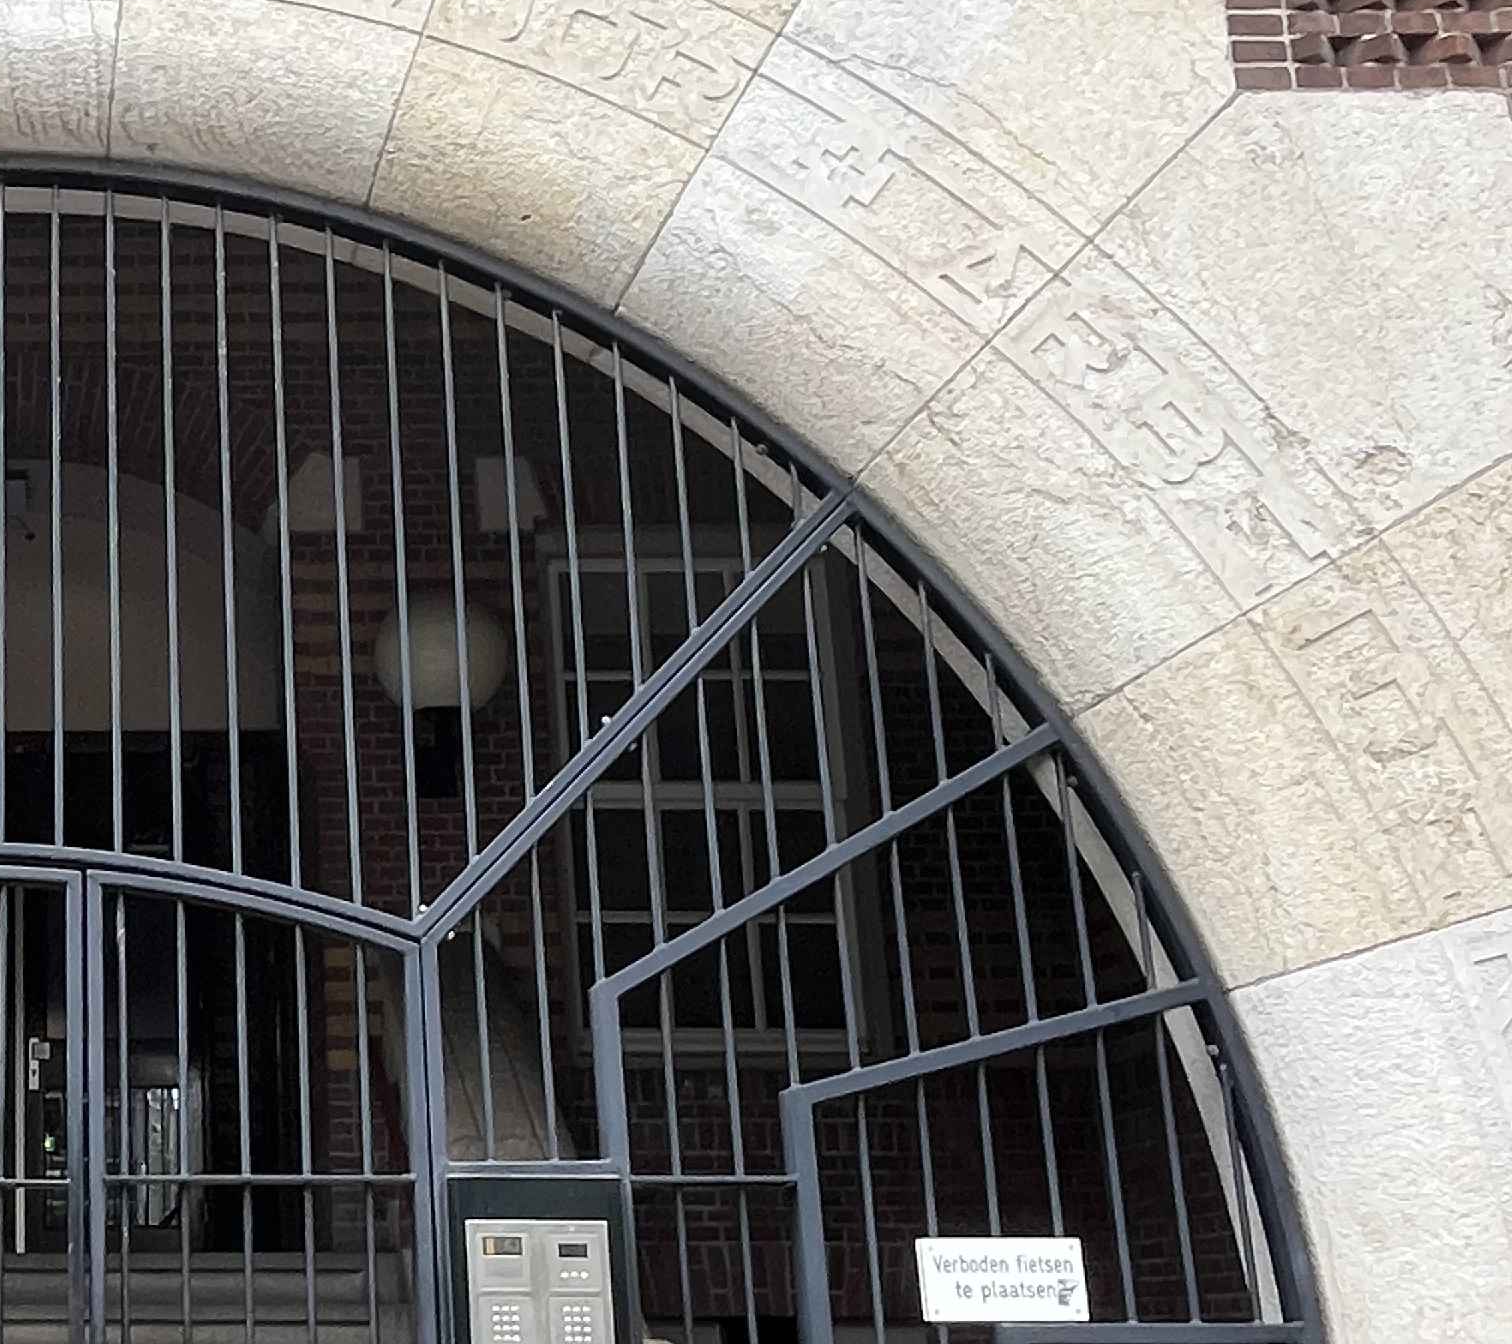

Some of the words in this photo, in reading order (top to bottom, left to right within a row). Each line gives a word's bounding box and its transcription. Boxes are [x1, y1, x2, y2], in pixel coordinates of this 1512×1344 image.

[933, 1254, 1010, 1274] Verboden
[1016, 1254, 1075, 1274] fietsen
[955, 1280, 973, 1299] te
[981, 1280, 1058, 1304] plaatsen
